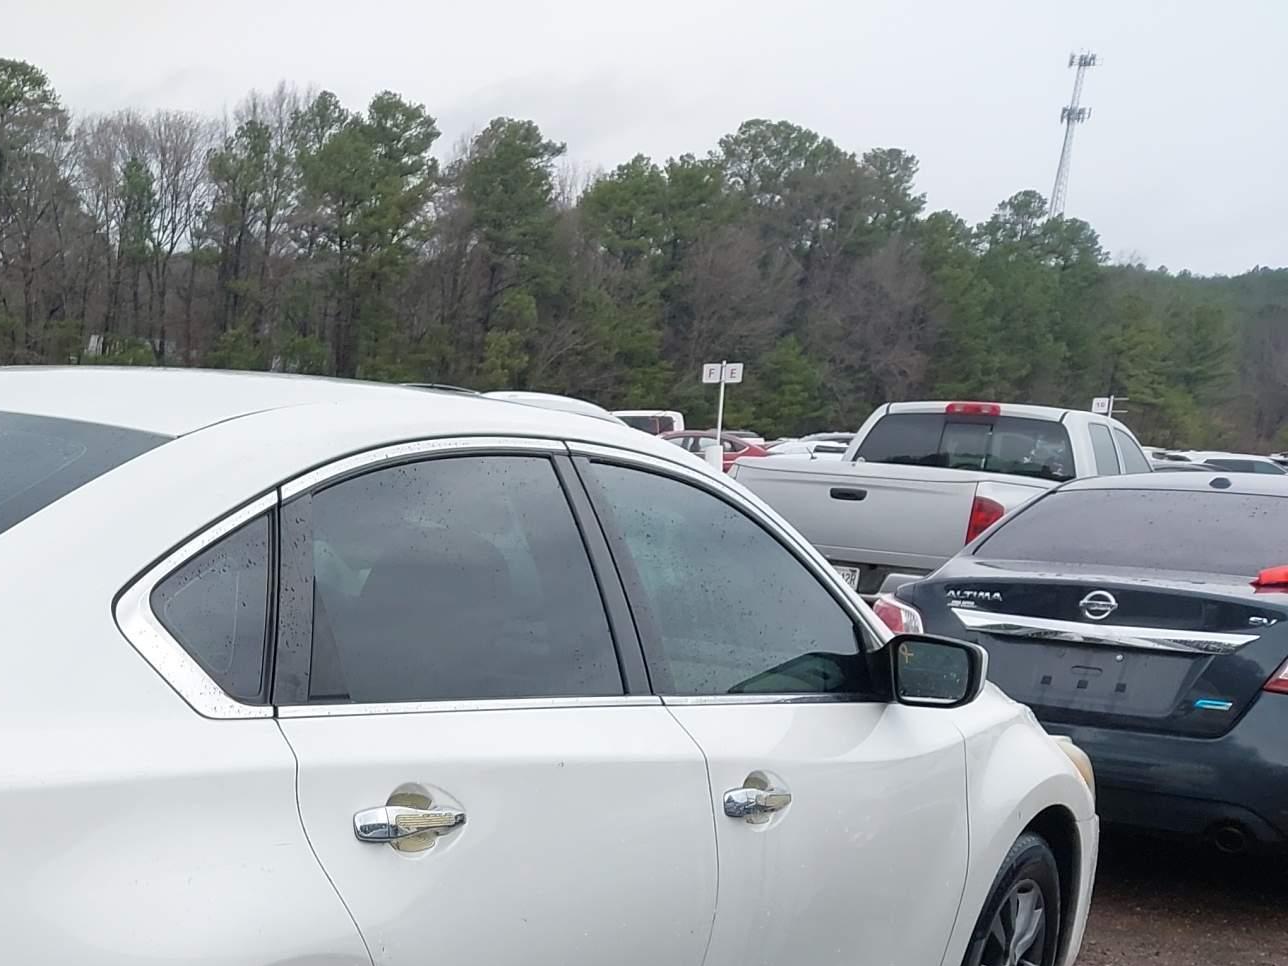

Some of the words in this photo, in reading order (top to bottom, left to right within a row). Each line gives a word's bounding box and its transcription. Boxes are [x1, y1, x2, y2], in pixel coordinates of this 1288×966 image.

[708, 368, 716, 379] F
[729, 368, 737, 379] E
[945, 589, 1004, 602] ALTIMA
[1248, 616, 1278, 628] SV
